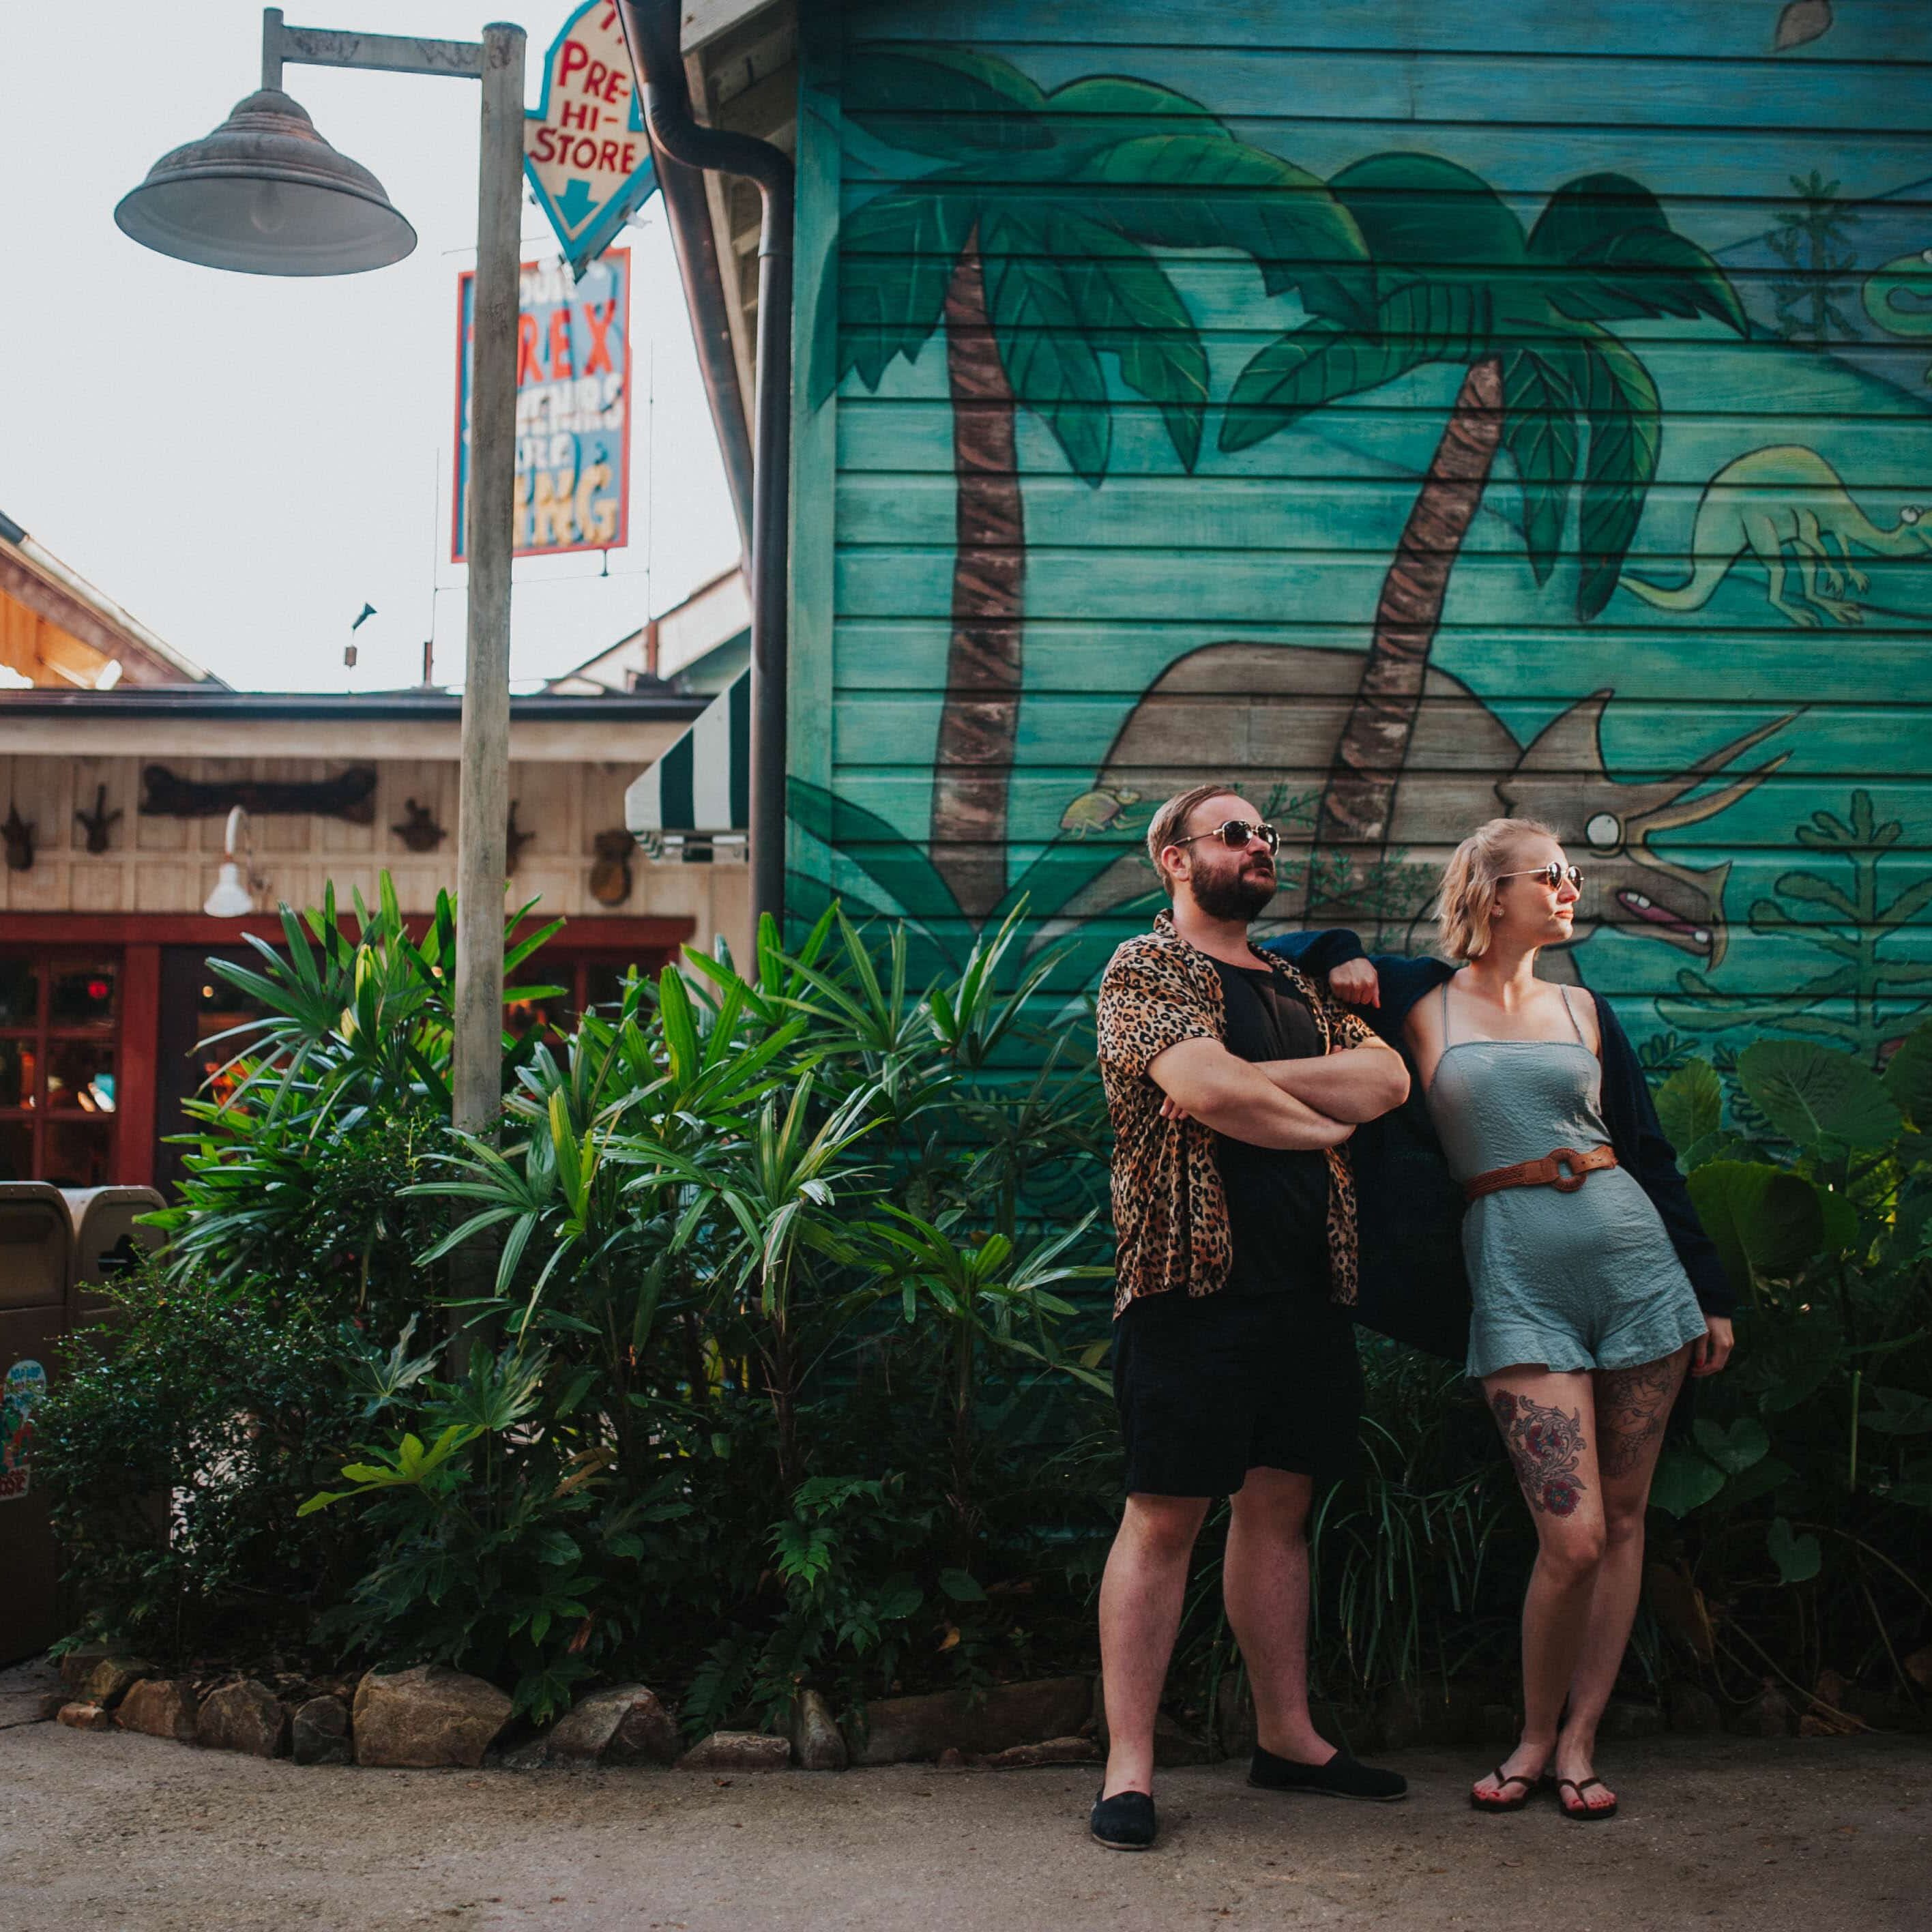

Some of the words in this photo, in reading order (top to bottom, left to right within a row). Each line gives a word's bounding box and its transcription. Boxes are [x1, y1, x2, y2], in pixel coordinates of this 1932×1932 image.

[557, 40, 629, 104] PRE-
[560, 100, 619, 132] HI-
[529, 128, 635, 175] STORE
